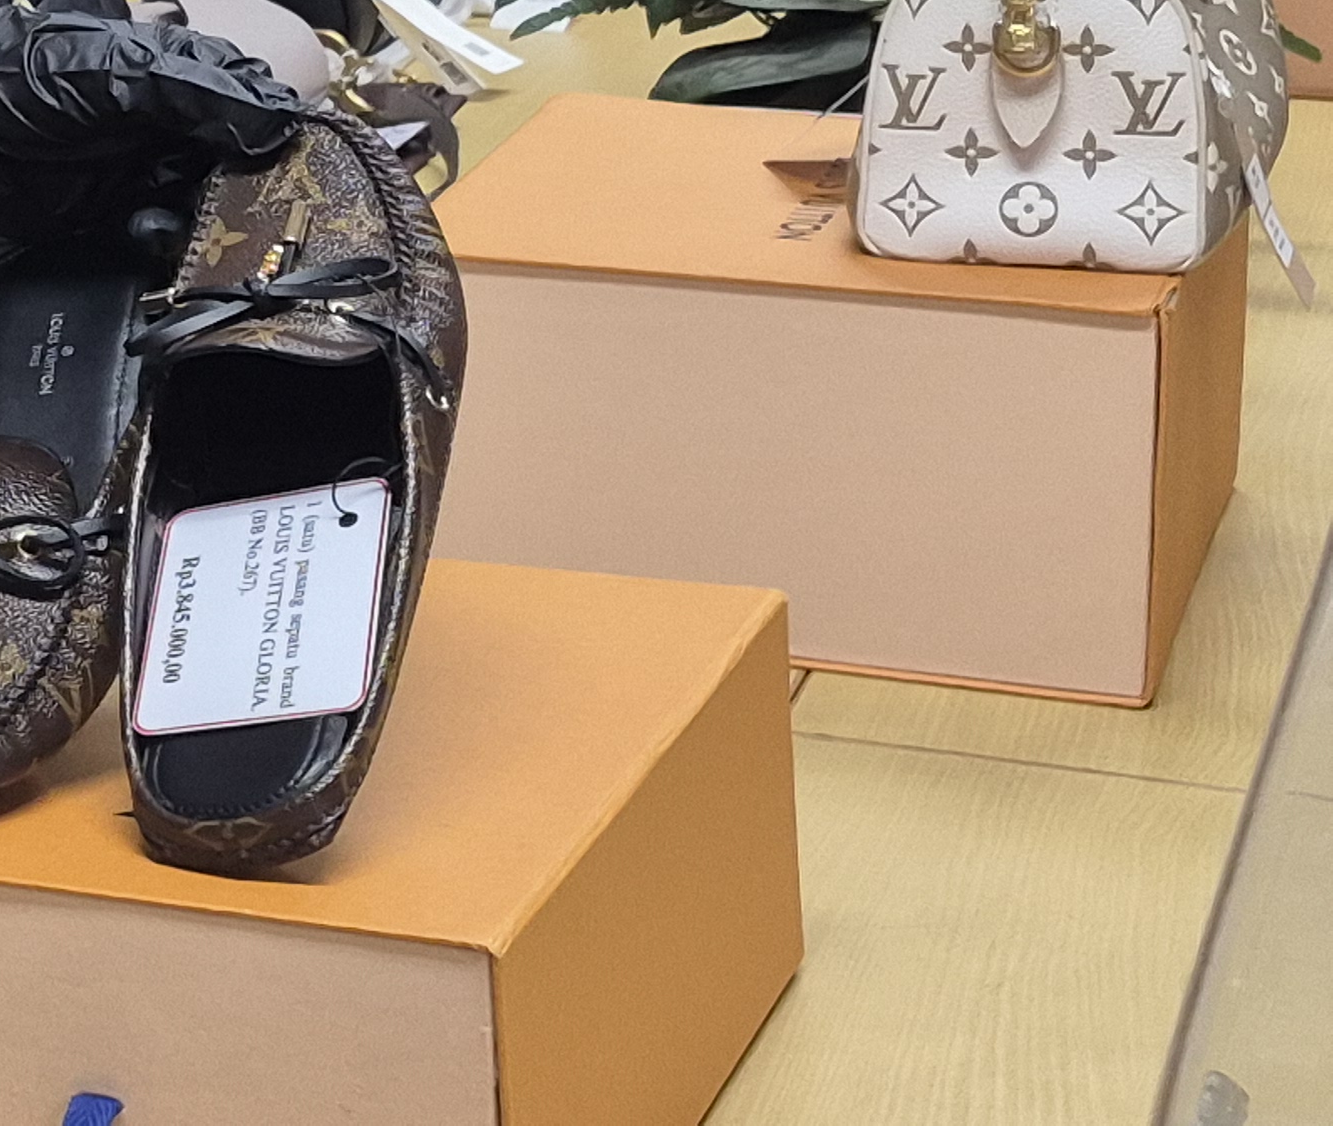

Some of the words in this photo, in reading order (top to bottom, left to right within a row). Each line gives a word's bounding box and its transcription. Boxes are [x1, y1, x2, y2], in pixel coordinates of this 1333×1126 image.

[249, 509, 267, 536] (BB
[273, 504, 296, 555] LOUIS
[161, 554, 201, 685] Rp3.845.000,00
[262, 557, 287, 634] VUITTON
[284, 613, 303, 660] sepatu
[279, 665, 301, 710] brand
